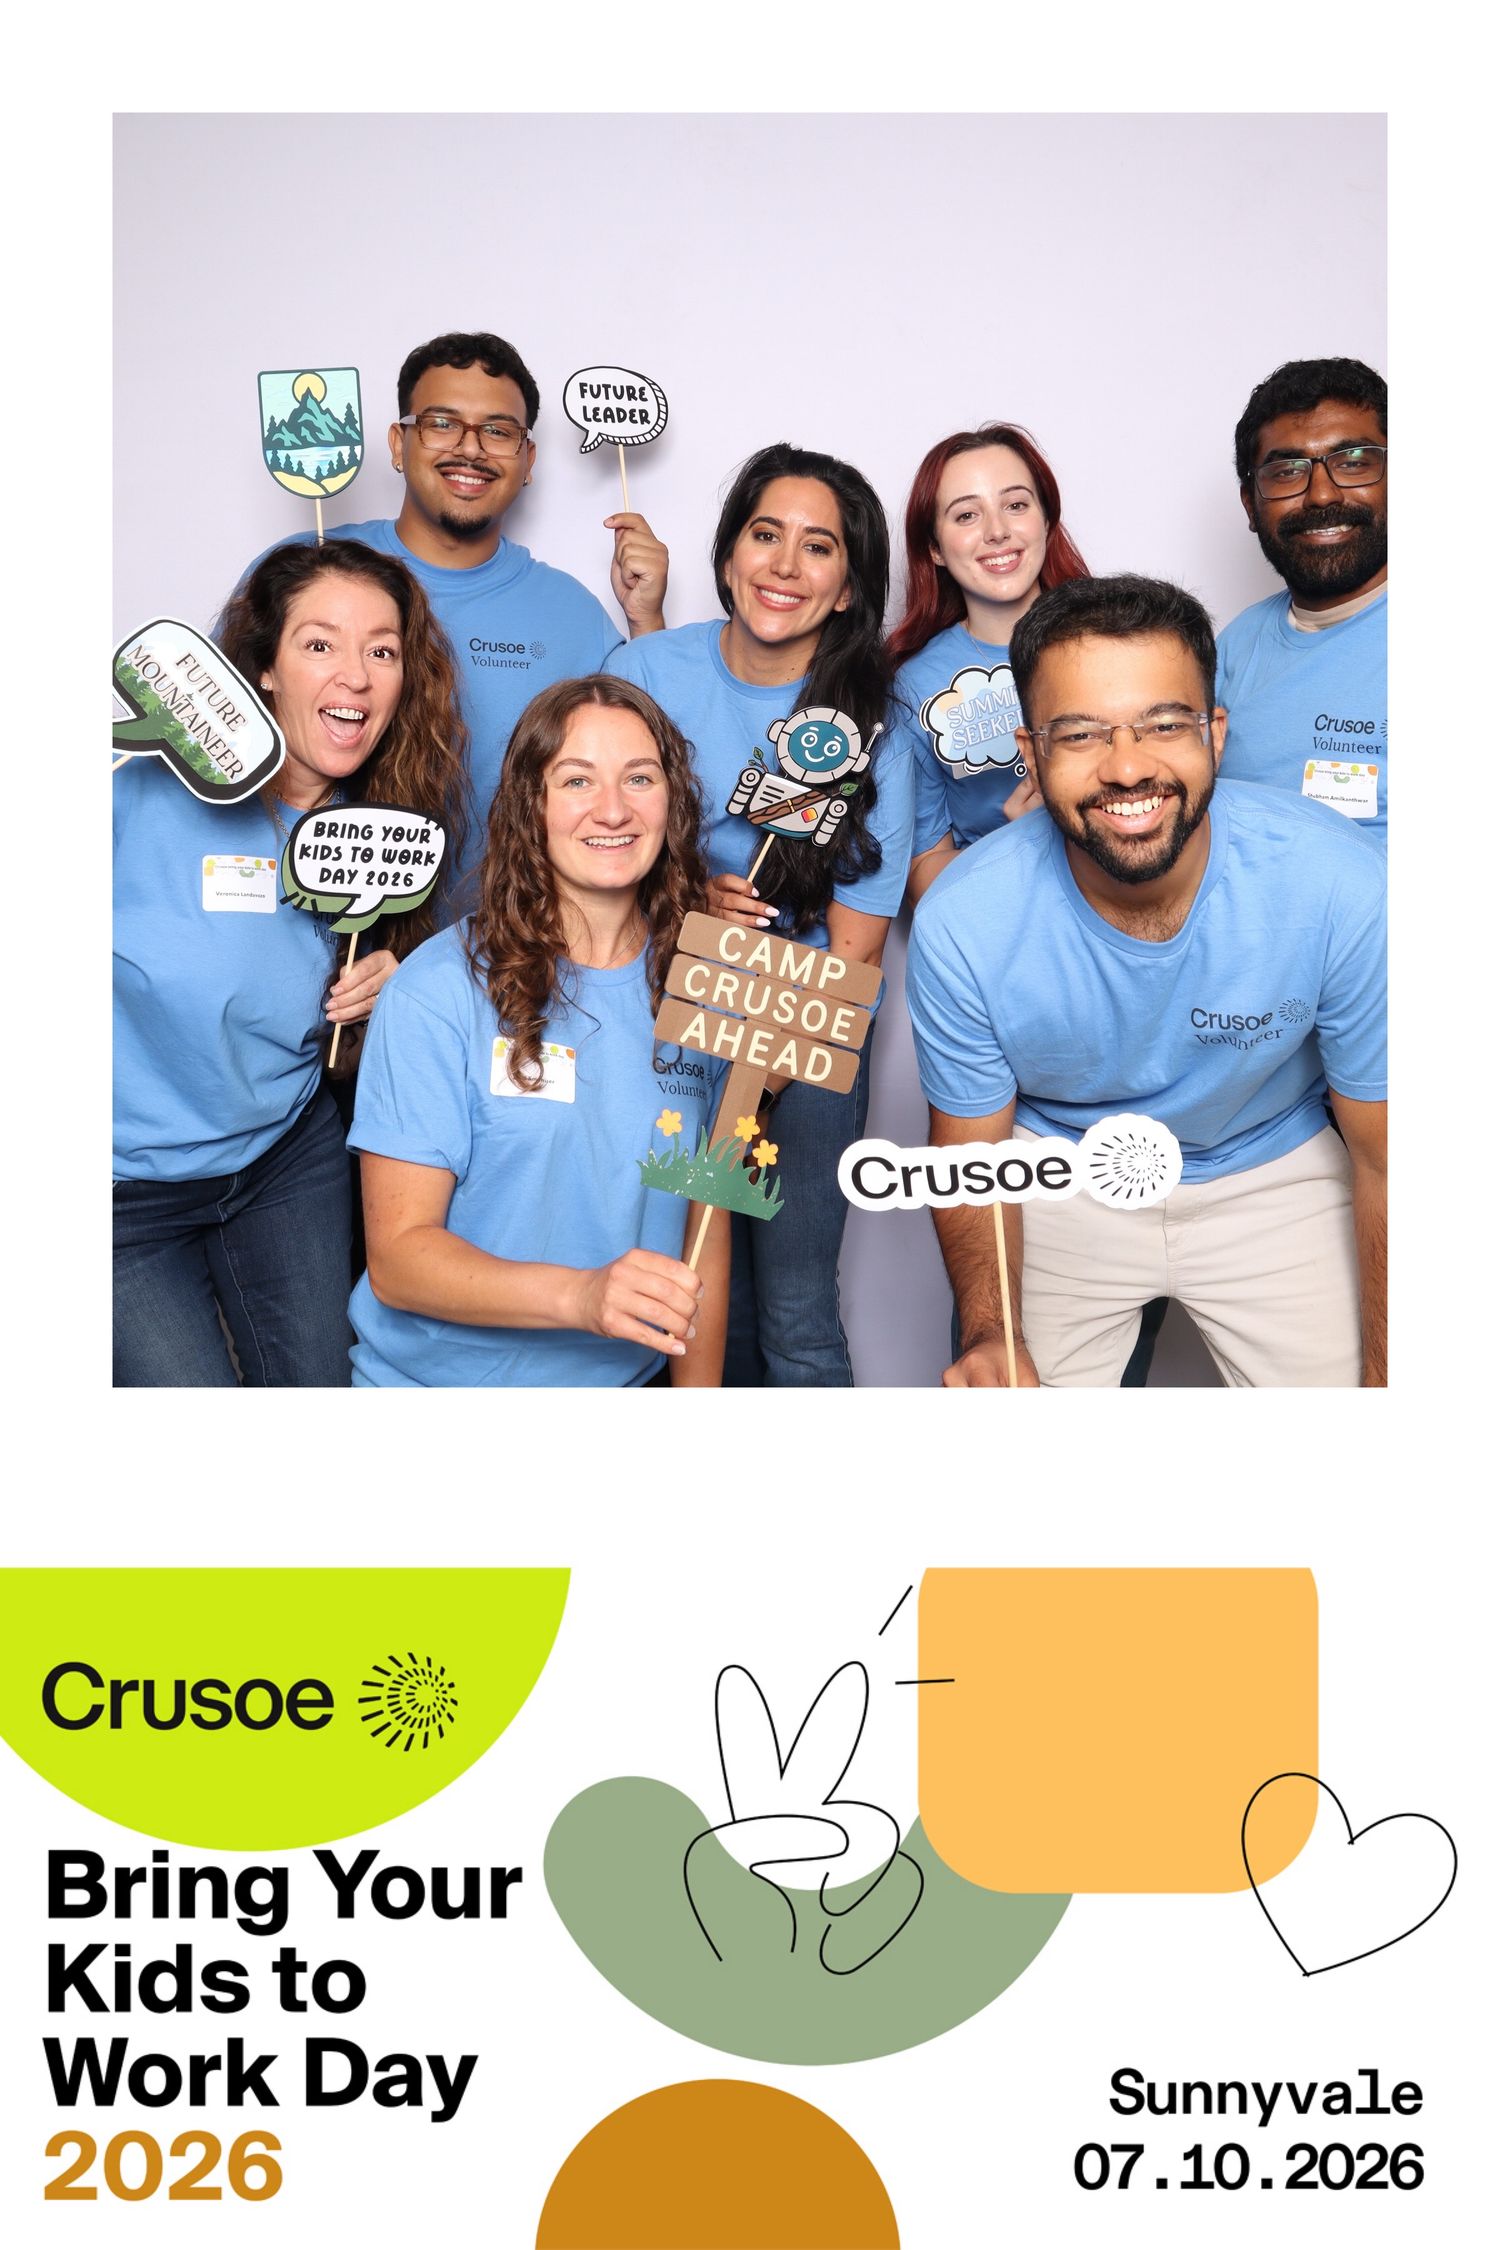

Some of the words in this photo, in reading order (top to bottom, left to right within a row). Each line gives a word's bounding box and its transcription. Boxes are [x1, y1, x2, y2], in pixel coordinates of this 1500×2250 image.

[578, 382, 649, 402] FUTURE
[582, 405, 651, 425] LEADER
[469, 638, 526, 654] Crusoe
[471, 655, 531, 670] Volunteer
[175, 652, 246, 732] FUTURE
[126, 644, 244, 780] MOUNTAINEER
[946, 685, 1019, 729] SUMMI
[1314, 713, 1375, 735] Crusoe
[1313, 736, 1382, 755] Volunteer
[381, 825, 431, 844] YOUR
[298, 843, 342, 861] KIDS
[351, 846, 374, 864] TO
[381, 848, 436, 866] WORK
[319, 867, 358, 885] DAY
[365, 870, 414, 887] 2026
[718, 926, 847, 989] CAMP
[684, 964, 856, 1042] CRUSOE
[1190, 1007, 1273, 1031] Crusoe
[679, 1011, 833, 1083] AHEAD
[851, 1156, 1072, 1199] Crusoe
